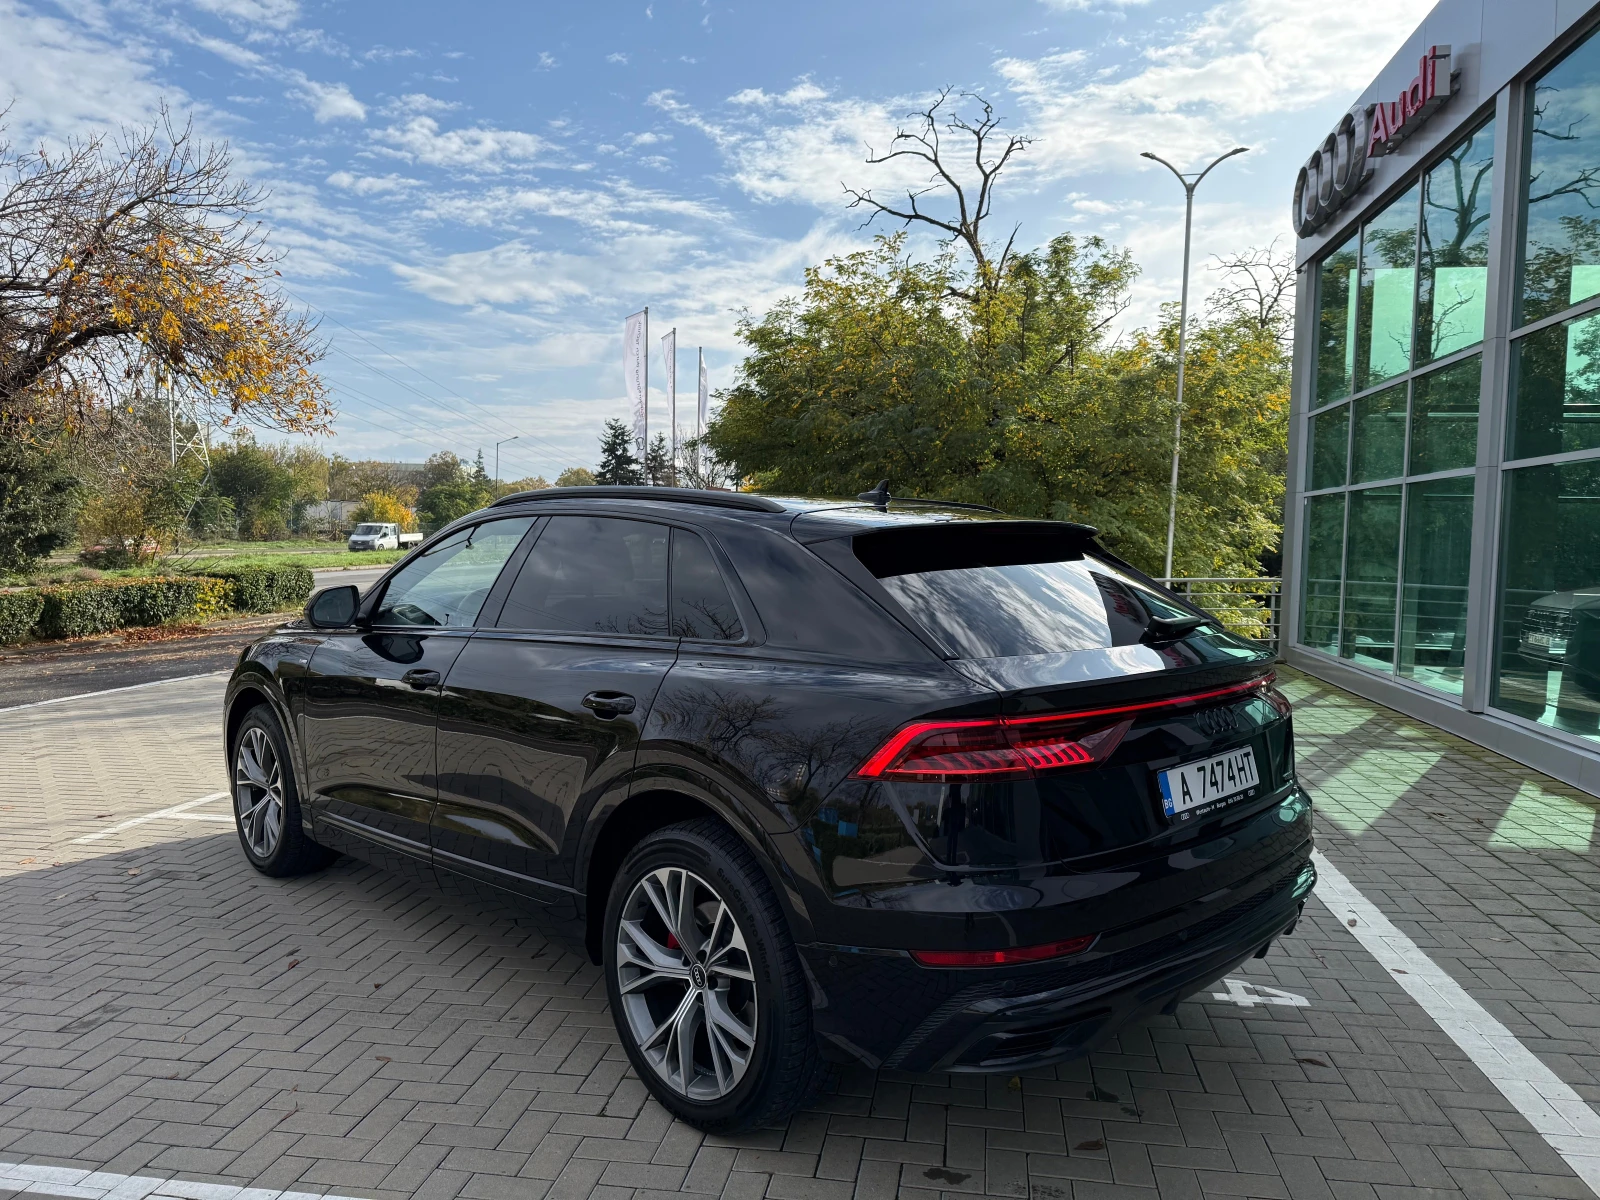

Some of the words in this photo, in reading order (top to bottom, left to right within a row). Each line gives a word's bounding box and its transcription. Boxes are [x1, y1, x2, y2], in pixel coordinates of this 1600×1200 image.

[1367, 45, 1446, 158] Audi
[1163, 797, 1173, 809] BG
[1180, 771, 1193, 805] A
[1196, 751, 1254, 799] 7474HT
[716, 867, 748, 914] SureGrip
[747, 913, 758, 937] Pro
[756, 938, 771, 983] Winter
